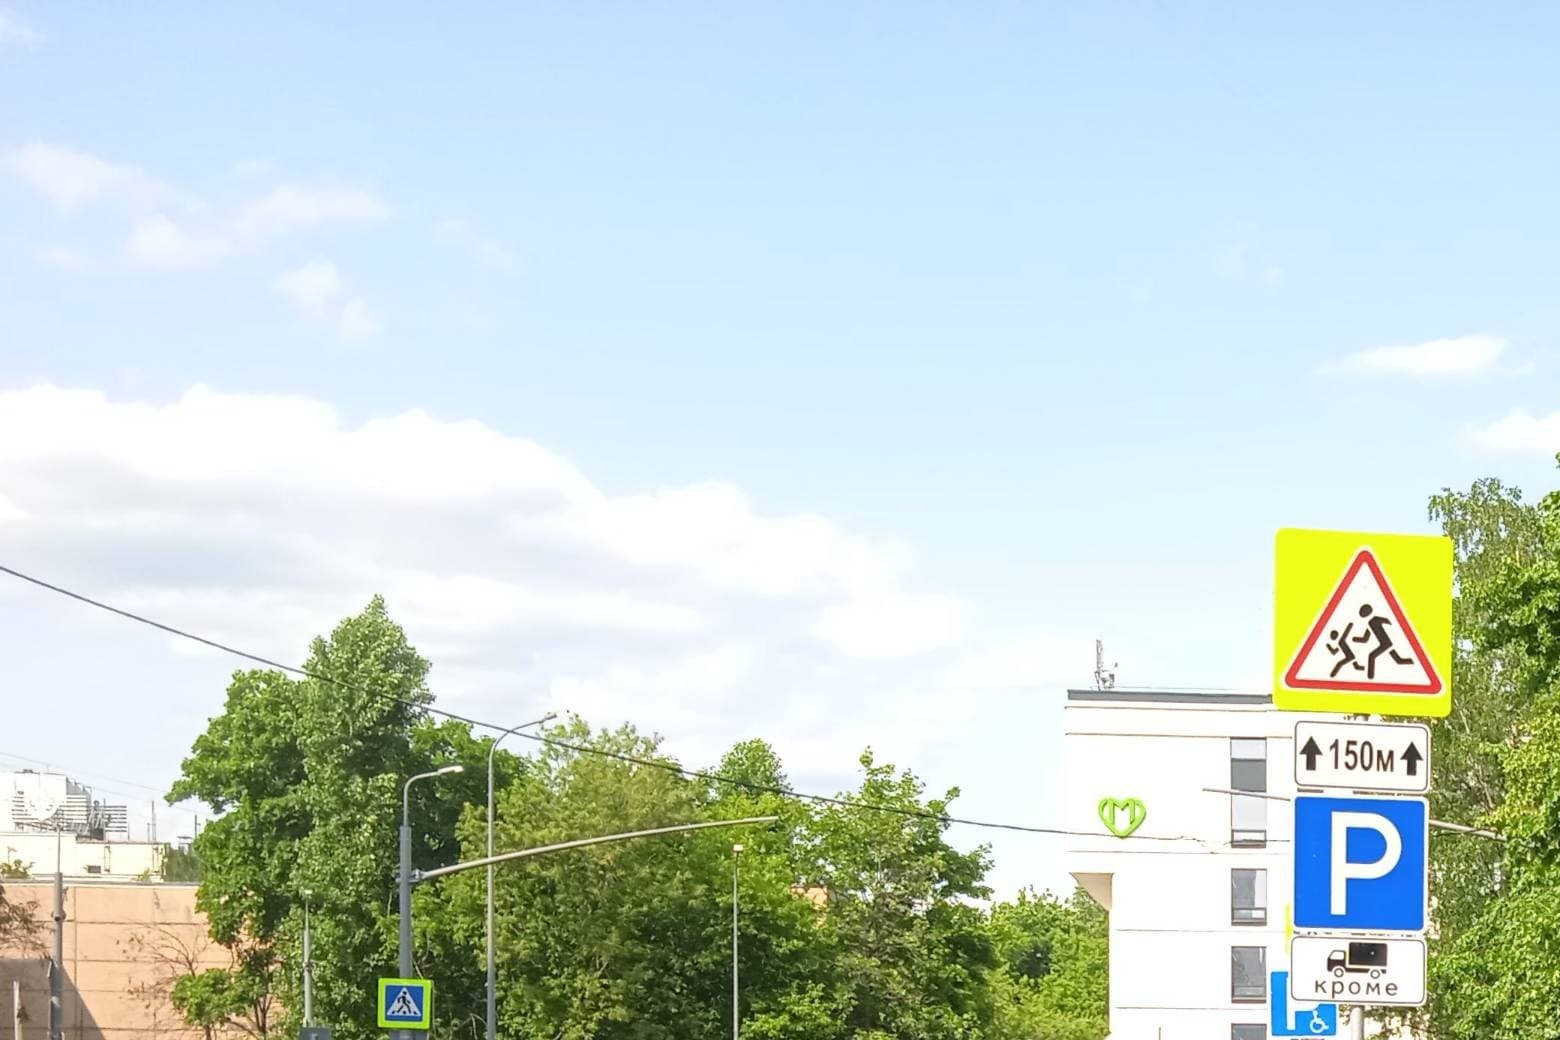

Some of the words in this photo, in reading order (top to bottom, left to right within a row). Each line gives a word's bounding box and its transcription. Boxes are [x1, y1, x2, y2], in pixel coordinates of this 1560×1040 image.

[1329, 738, 1395, 773] 150м
[1330, 810, 1402, 916] P
[1314, 980, 1398, 999] кроме
